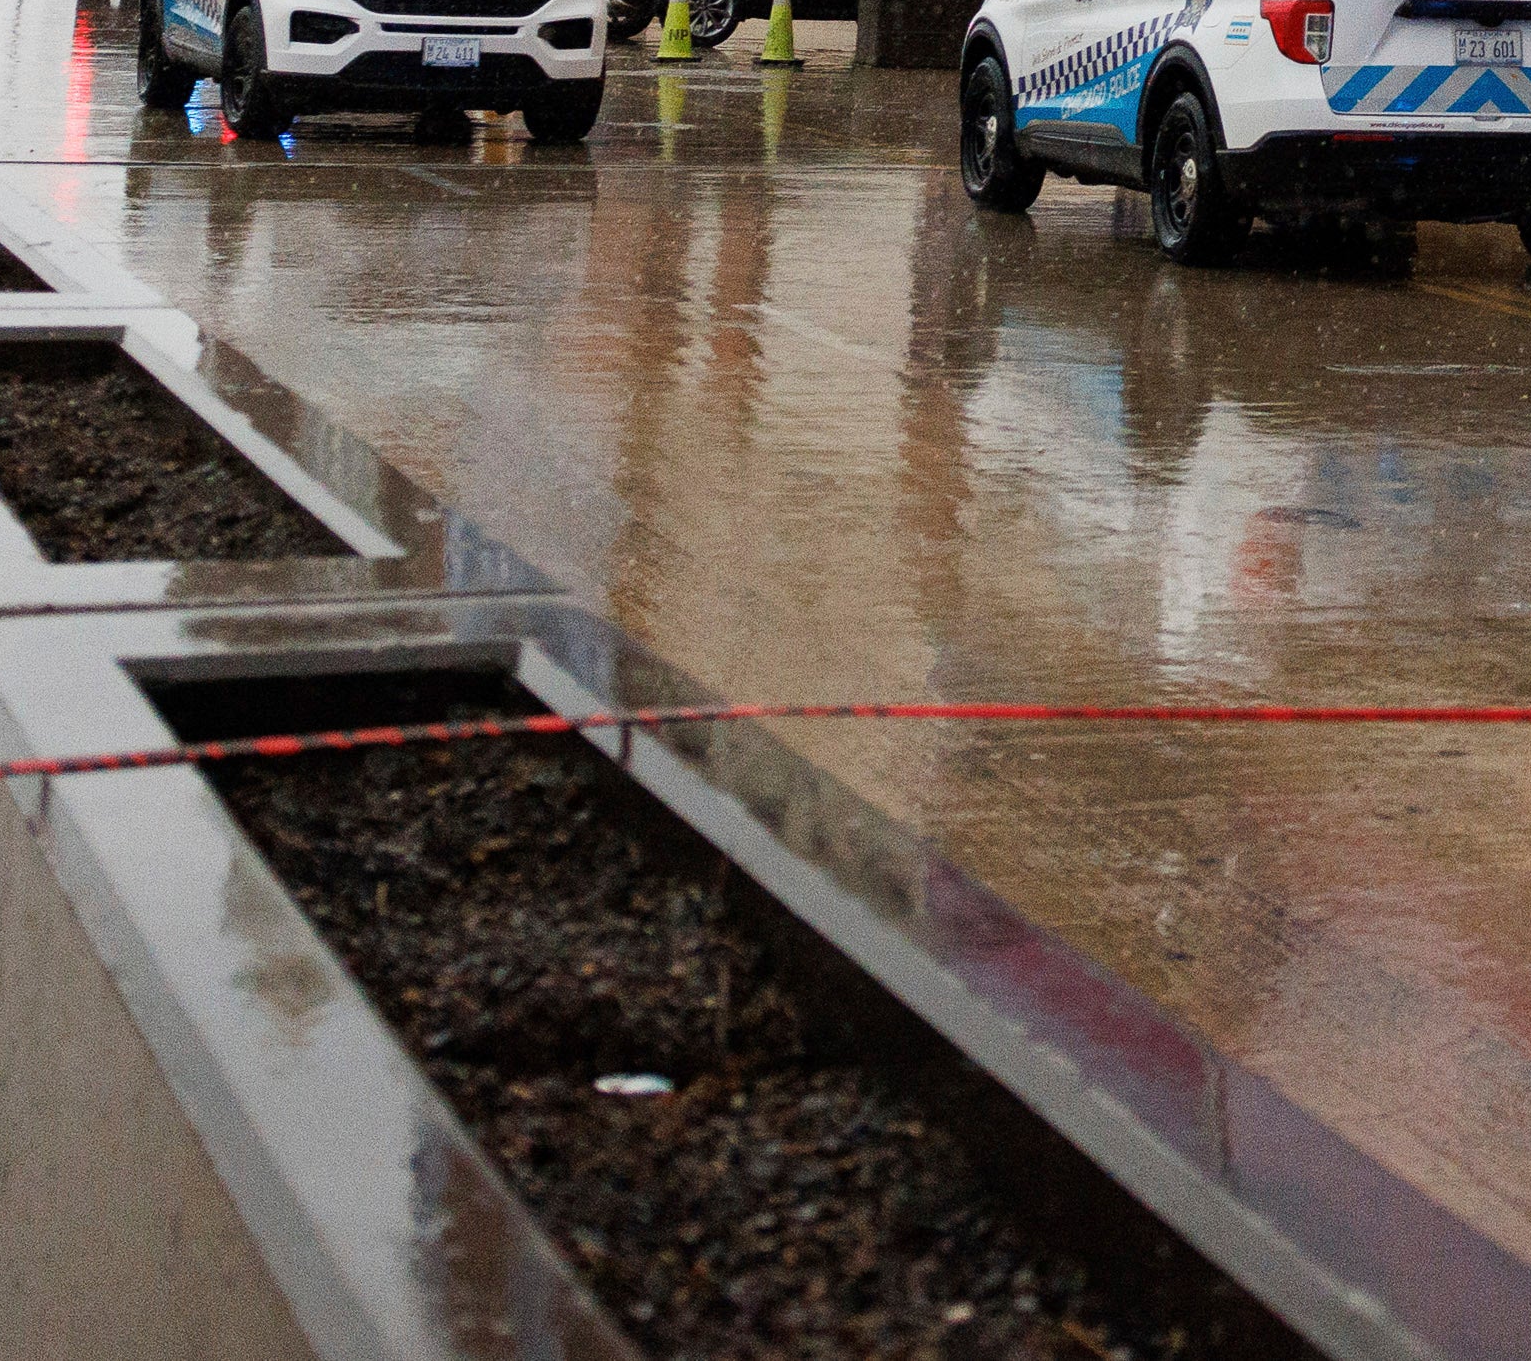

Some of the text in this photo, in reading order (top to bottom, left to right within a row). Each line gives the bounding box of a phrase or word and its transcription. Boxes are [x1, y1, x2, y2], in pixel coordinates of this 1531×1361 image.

[669, 29, 688, 41] NP
[1470, 40, 1485, 58] 23
[1493, 40, 1517, 58] 601
[1061, 62, 1141, 119] CHICAGO POLICE
